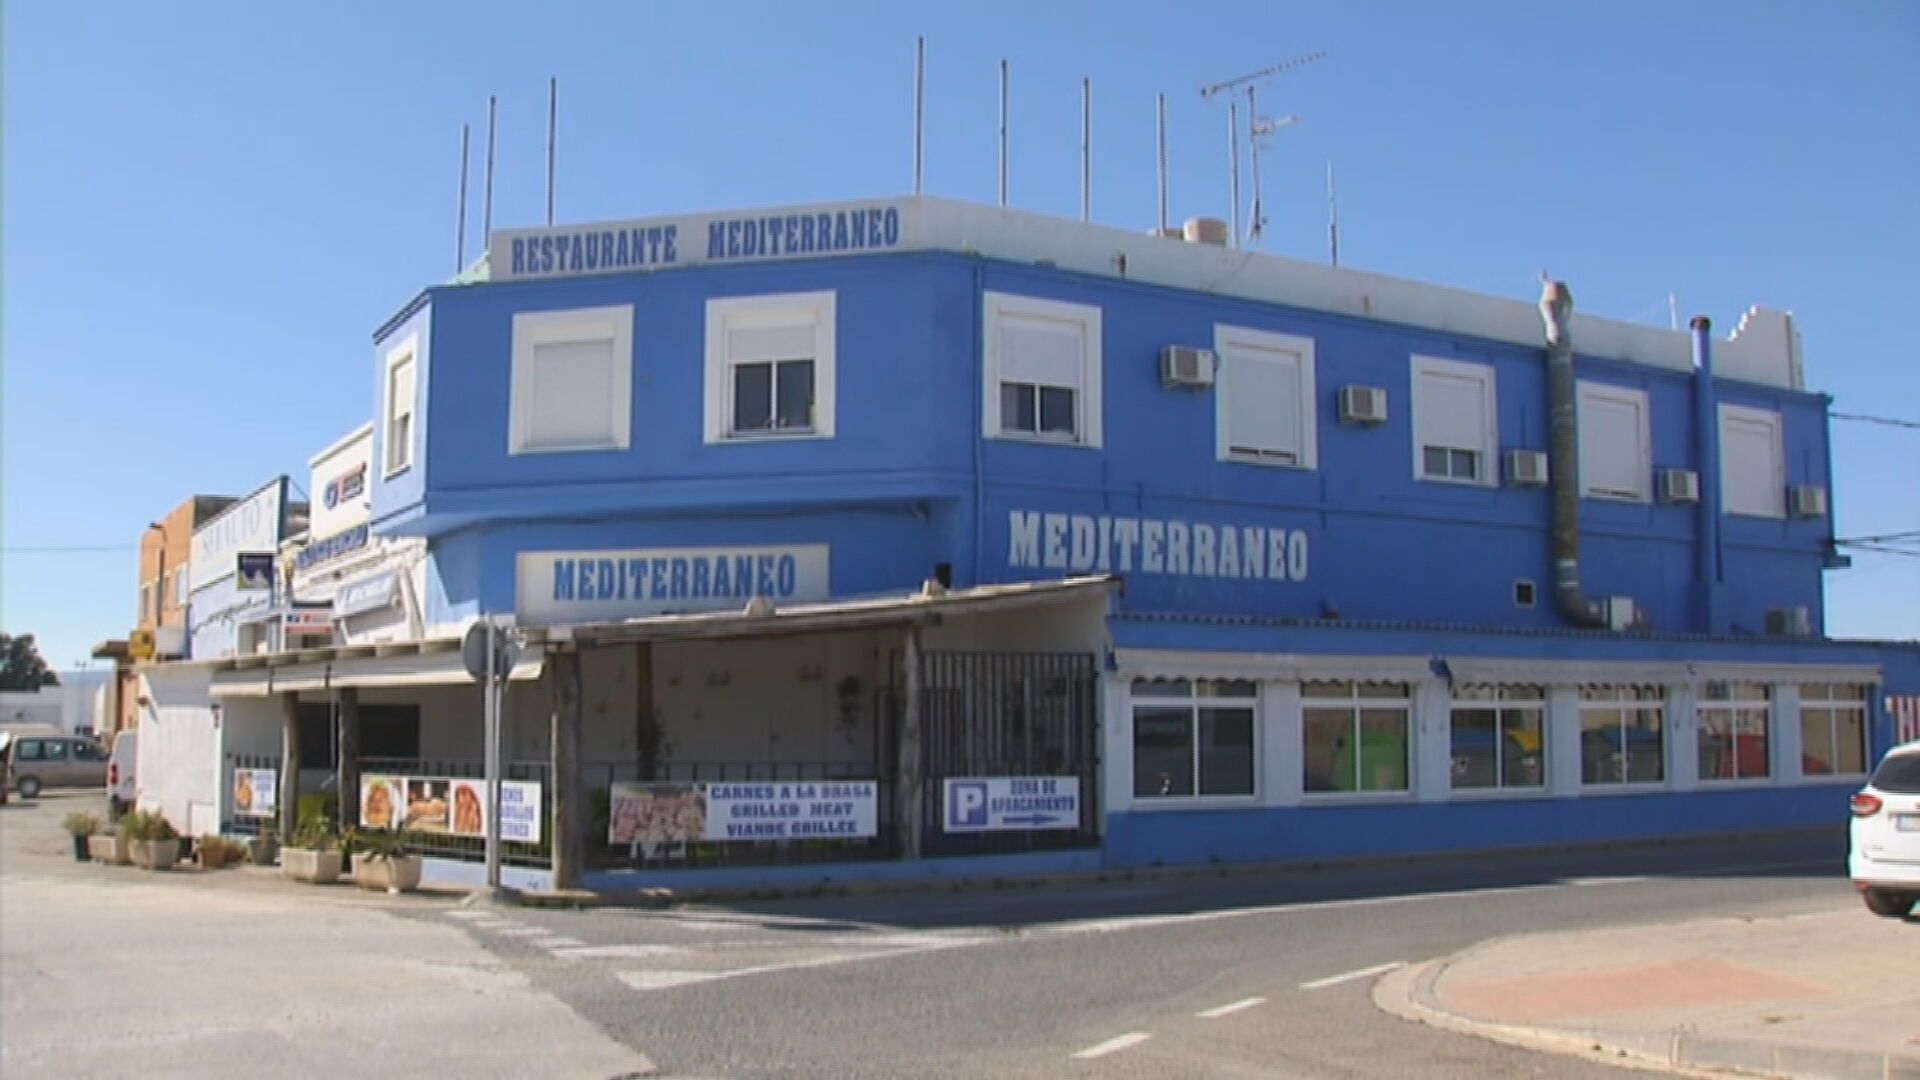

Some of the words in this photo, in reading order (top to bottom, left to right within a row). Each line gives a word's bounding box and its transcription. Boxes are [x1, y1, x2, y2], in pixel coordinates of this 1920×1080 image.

[511, 225, 677, 275] RESTAURANTE
[707, 206, 899, 260] MEDITERRANEO
[1008, 510, 1309, 582] MEDITERRANEO
[553, 553, 796, 600] MEDITERRANEO
[711, 784, 775, 801] CARNES
[780, 784, 790, 799] A
[796, 784, 817, 799] LA
[821, 783, 873, 799] BRASA
[730, 803, 800, 819] GRILLED
[810, 802, 854, 818] MEAT
[727, 822, 786, 837] VIANDE
